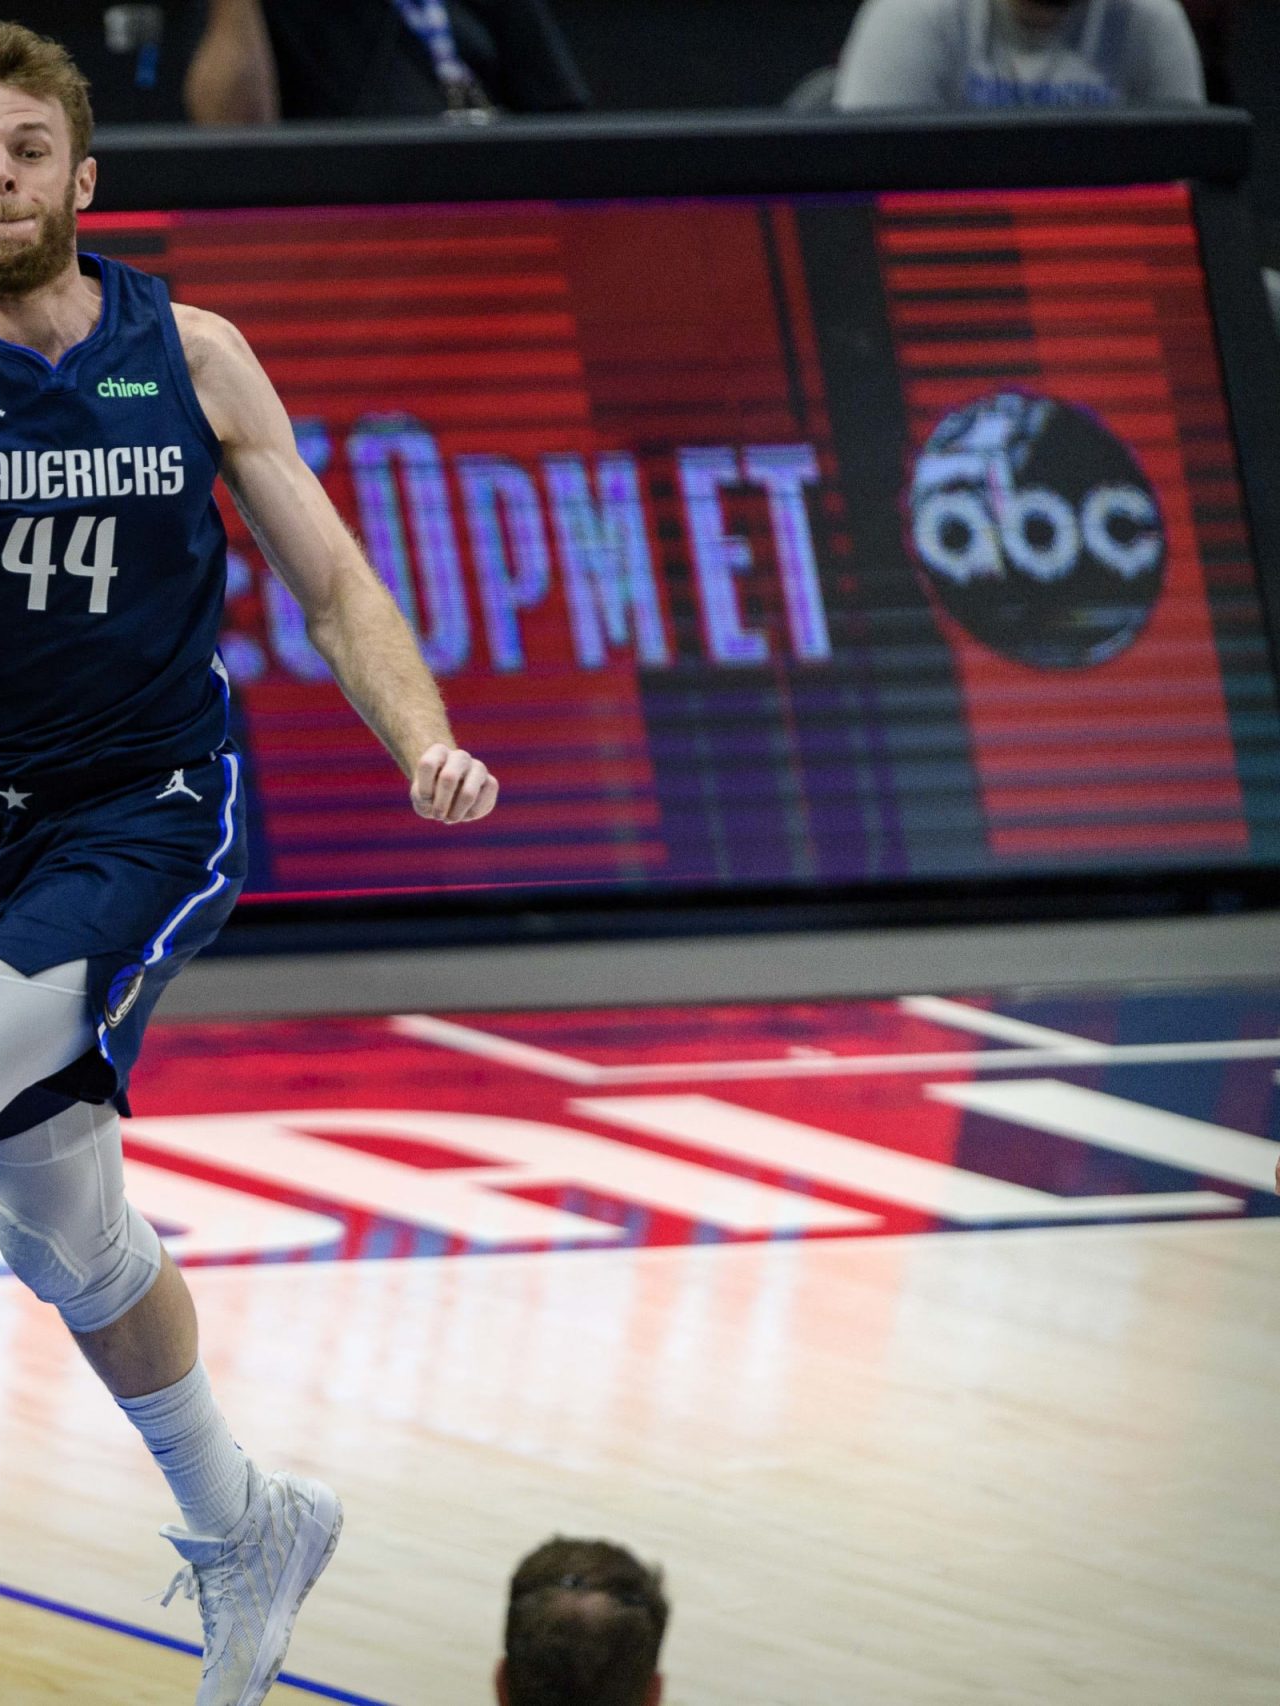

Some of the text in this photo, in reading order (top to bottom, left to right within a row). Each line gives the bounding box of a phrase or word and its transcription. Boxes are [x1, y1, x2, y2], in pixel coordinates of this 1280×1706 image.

[97, 376, 159, 398] chime
[1, 515, 119, 614] 44
[676, 442, 833, 666] ET
[913, 462, 1163, 585] abc
